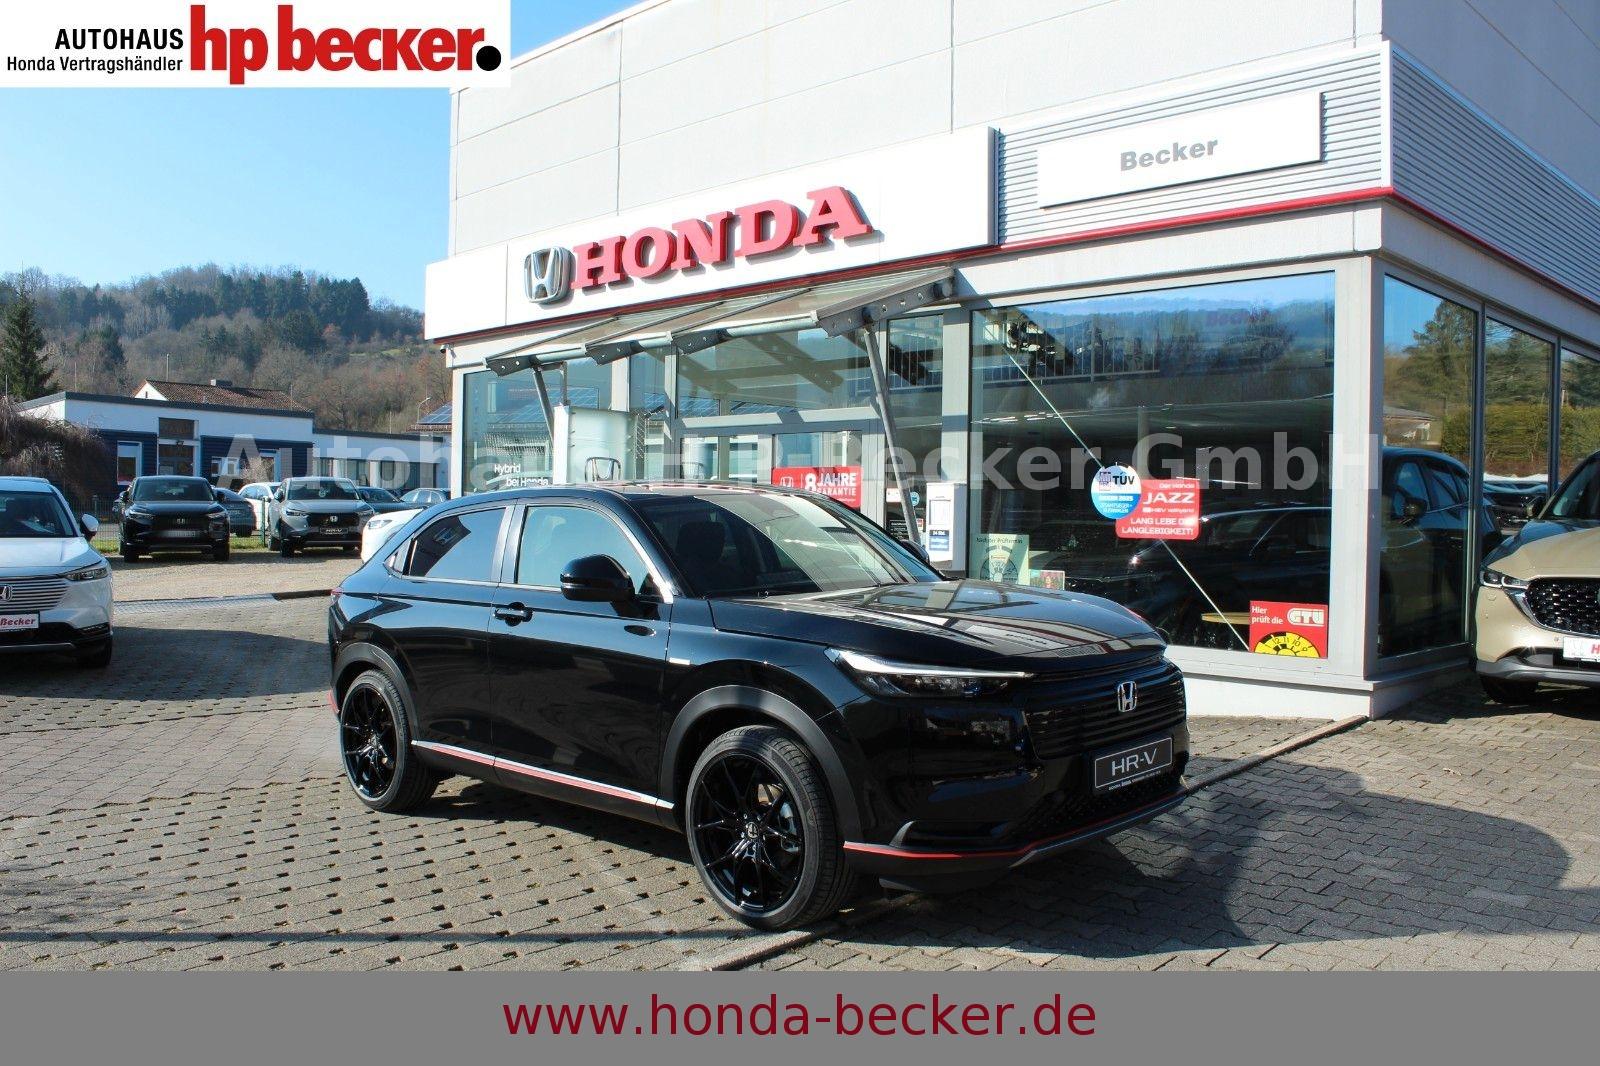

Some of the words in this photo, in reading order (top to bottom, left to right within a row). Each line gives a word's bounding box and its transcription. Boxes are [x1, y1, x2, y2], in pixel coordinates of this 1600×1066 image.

[1120, 139, 1218, 171] Becker
[571, 186, 874, 290] HONDA
[494, 463, 521, 475] Hybrid
[804, 473, 817, 492] 8
[817, 472, 857, 487] JAHRE
[1142, 492, 1195, 505] JAZZ
[1130, 517, 1153, 525] LANG
[1155, 518, 1177, 526] LEBE
[1251, 606, 1268, 614] Hier
[1251, 616, 1271, 625] prüft
[1271, 616, 1284, 625] die
[1111, 747, 1157, 777] HR-V
